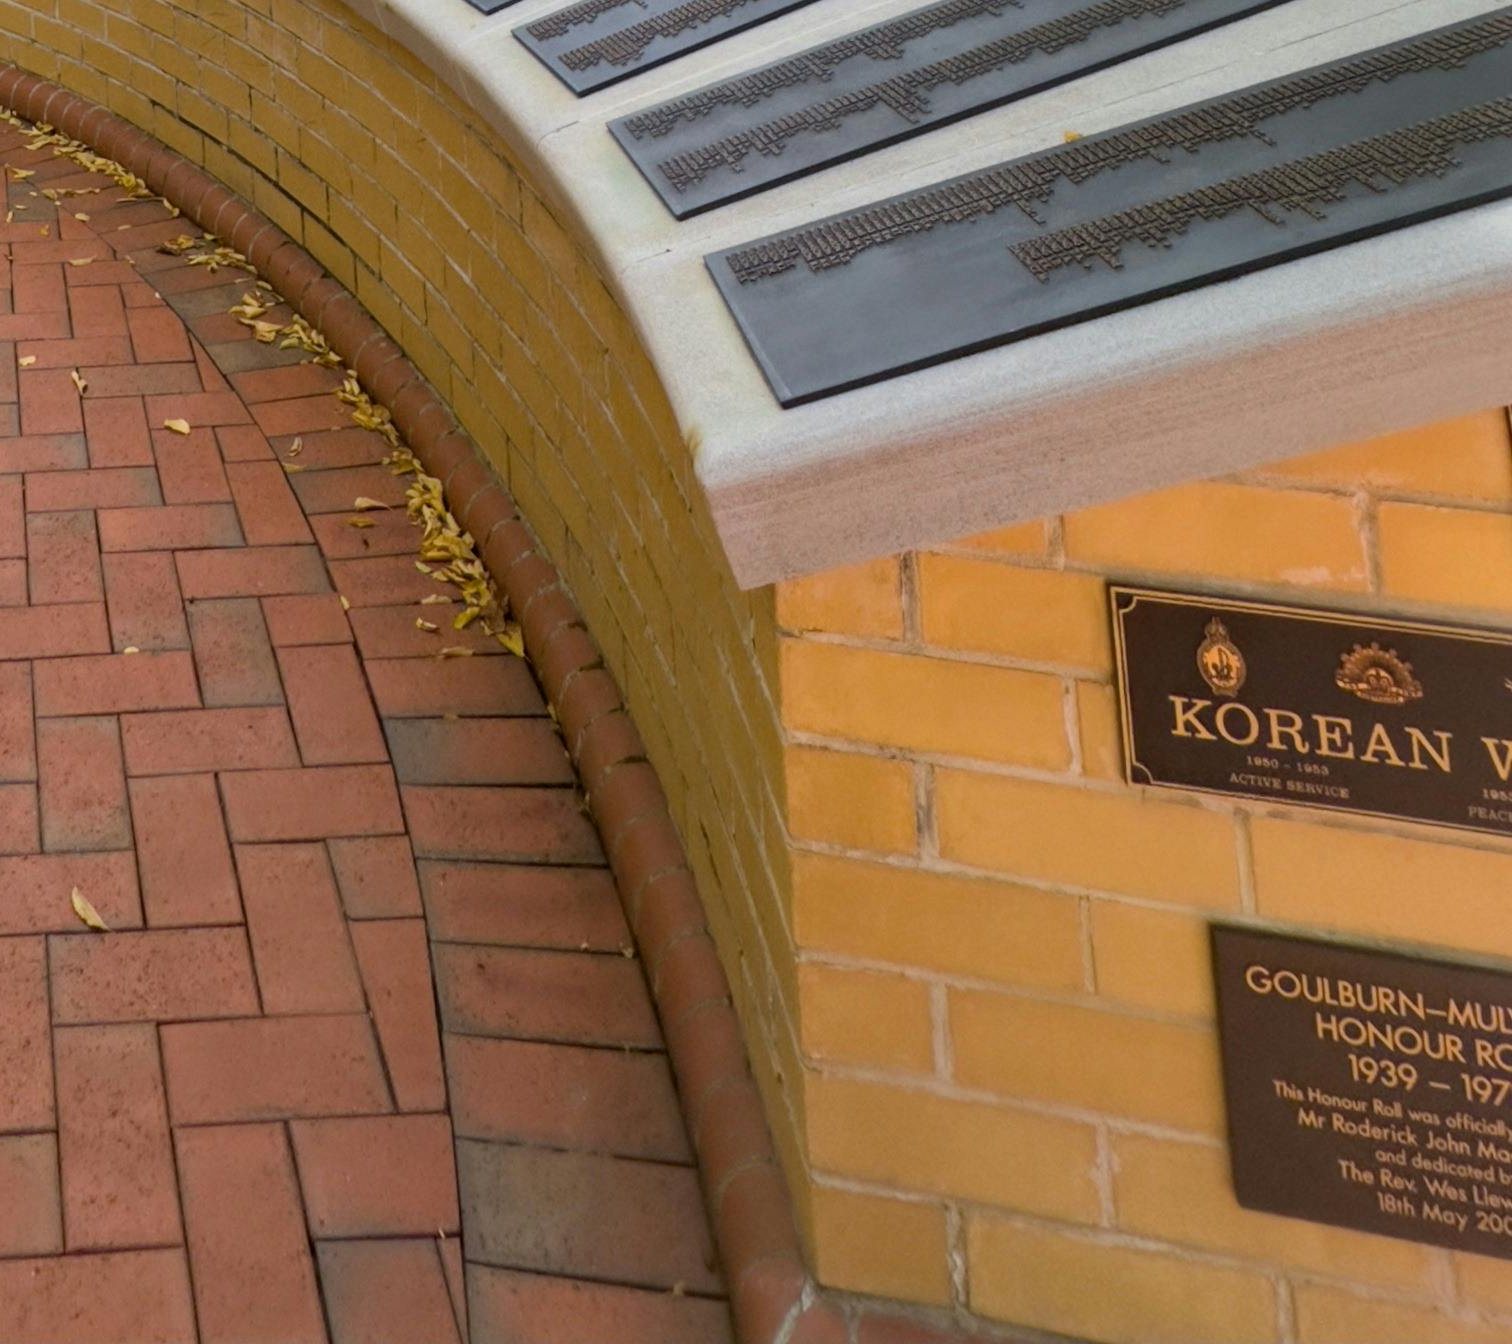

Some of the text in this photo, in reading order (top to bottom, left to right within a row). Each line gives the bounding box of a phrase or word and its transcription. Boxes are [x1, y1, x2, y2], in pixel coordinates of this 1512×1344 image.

[1169, 695, 1453, 773] KOREAN
[1229, 772, 1350, 799] ACTIVE SERVICE
[1315, 1012, 1466, 1064] HONOUR
[1349, 1053, 1418, 1092] 1939
[1273, 1078, 1304, 1103] This
[1308, 1087, 1368, 1113] Honour
[1373, 1097, 1403, 1118] Roll
[1408, 1108, 1441, 1126] was
[1298, 1108, 1326, 1129] Mr
[1332, 1112, 1418, 1147] Roderick
[1426, 1130, 1471, 1157] John
[1338, 1159, 1375, 1185] The
[1423, 1175, 1468, 1204] Wes
[1375, 1148, 1407, 1167] and
[1412, 1152, 1495, 1184] dedicated
[1377, 1191, 1416, 1217] 18th
[1422, 1200, 1468, 1232] May
